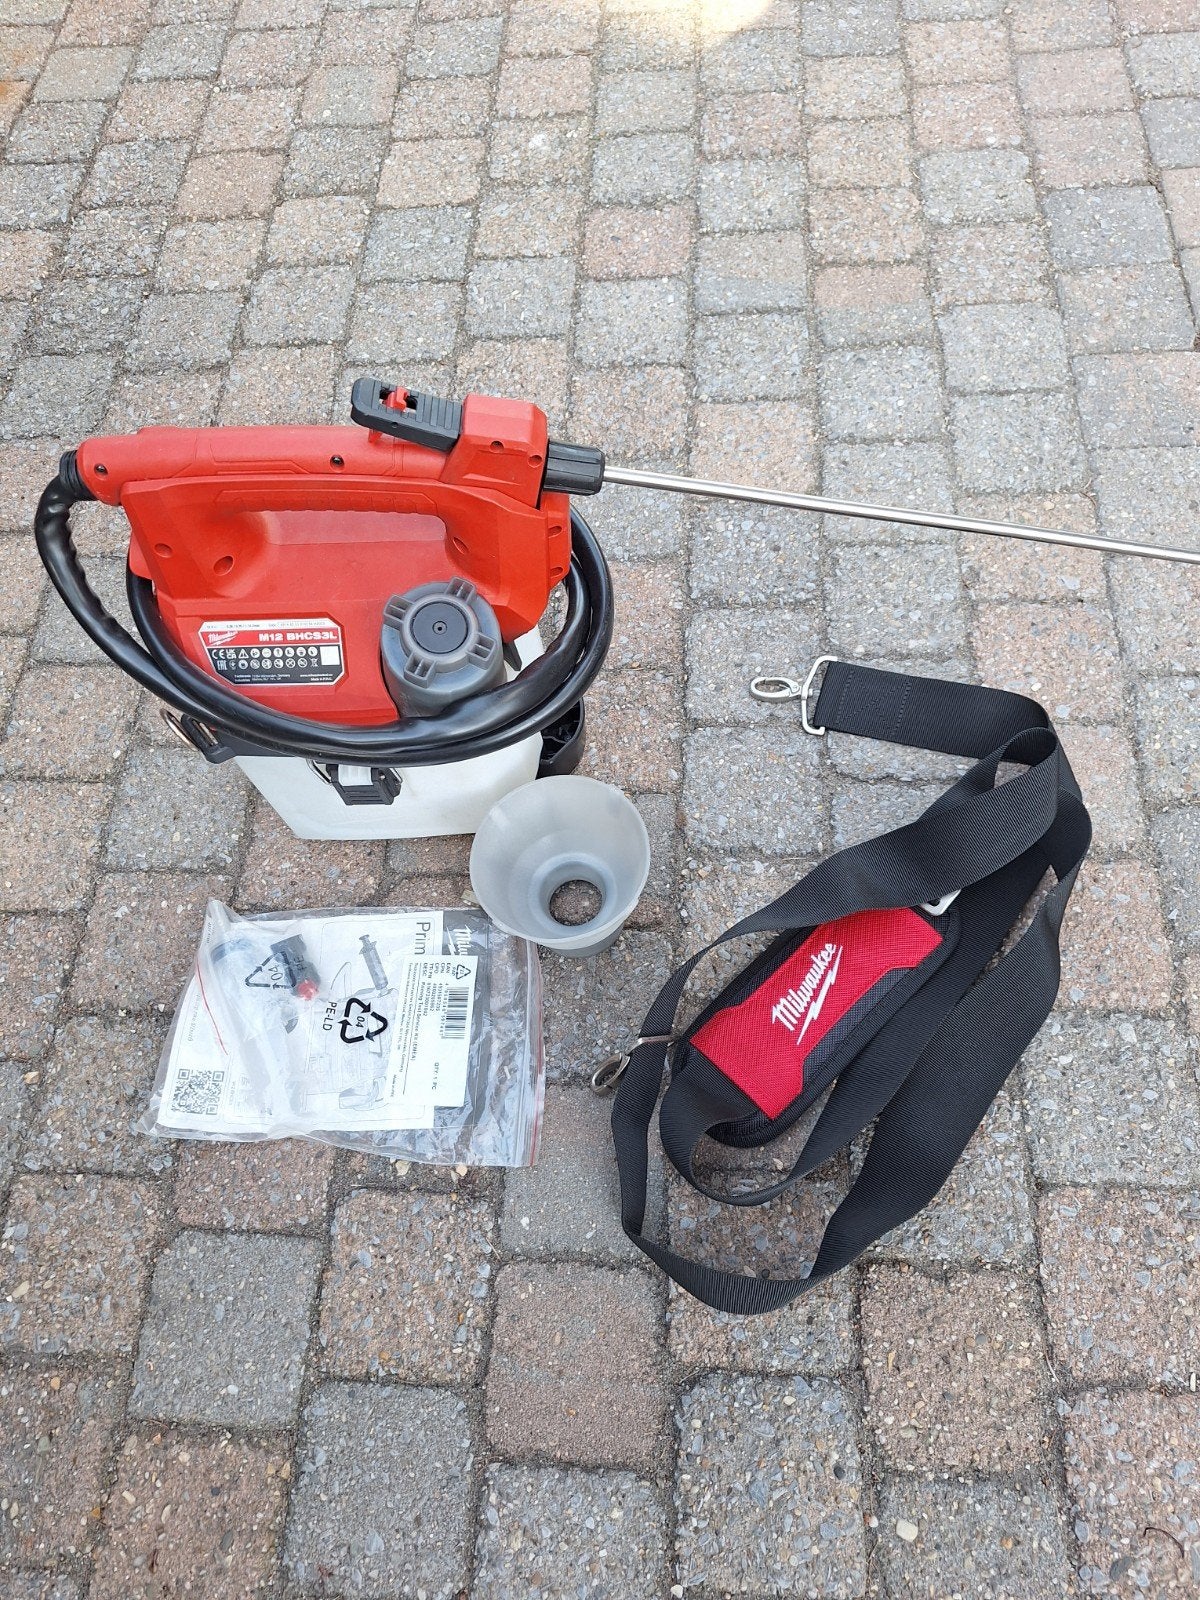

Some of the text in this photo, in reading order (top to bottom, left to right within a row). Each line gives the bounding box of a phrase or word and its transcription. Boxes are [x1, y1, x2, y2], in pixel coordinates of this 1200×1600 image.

[258, 631, 338, 642] M12 BHCS3L
[414, 922, 431, 955] Prim
[771, 943, 837, 1031] Milwaukee
[323, 1001, 338, 1031] PE-LD
[355, 1015, 366, 1029] 04
